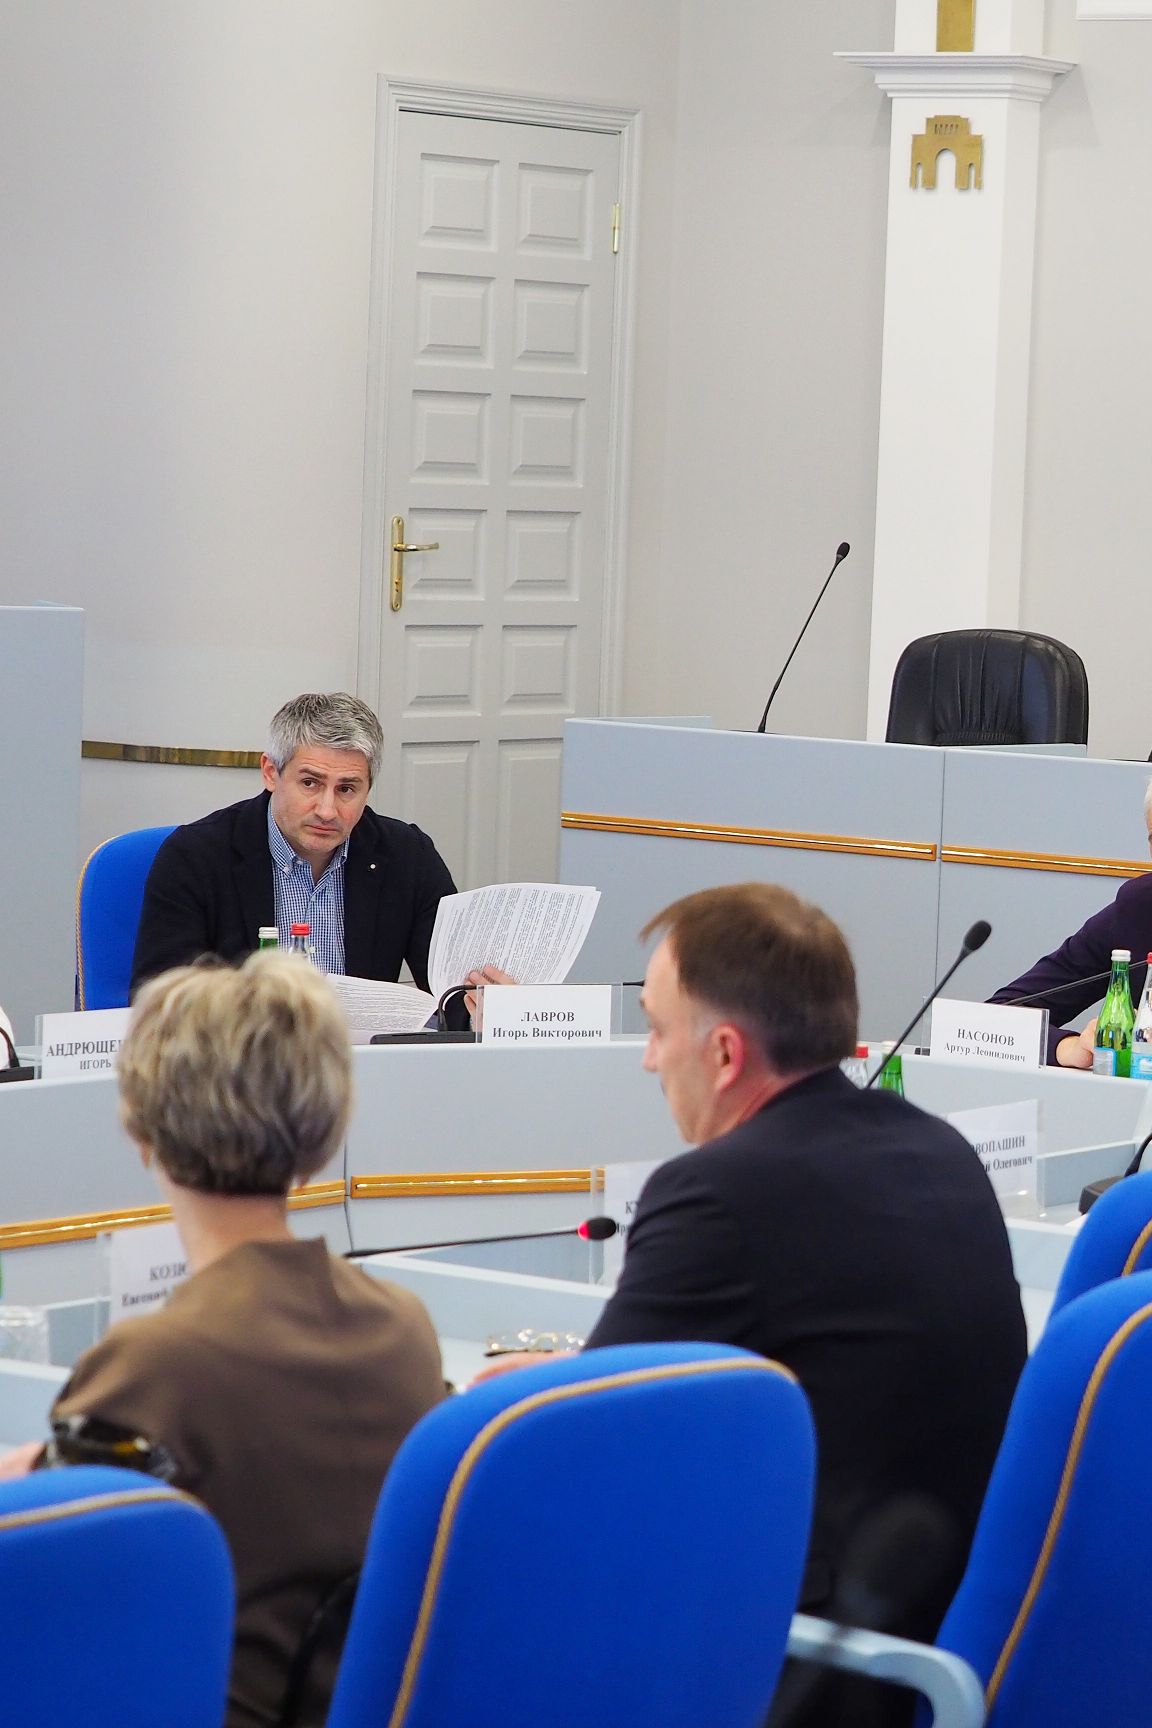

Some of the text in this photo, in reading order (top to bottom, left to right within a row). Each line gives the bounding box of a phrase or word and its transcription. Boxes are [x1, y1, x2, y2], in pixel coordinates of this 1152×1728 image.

[520, 1011, 575, 1022] ЛАВРОВ
[493, 1027, 602, 1040] Игорь Викторович
[957, 1028, 1015, 1046] НАСОНОВ
[944, 1042, 1026, 1062] Артур Леонидович
[79, 1058, 112, 1070] ИГОРЬ
[971, 1135, 1025, 1155] ВОПАШИН
[993, 1156, 1033, 1171] Олегович
